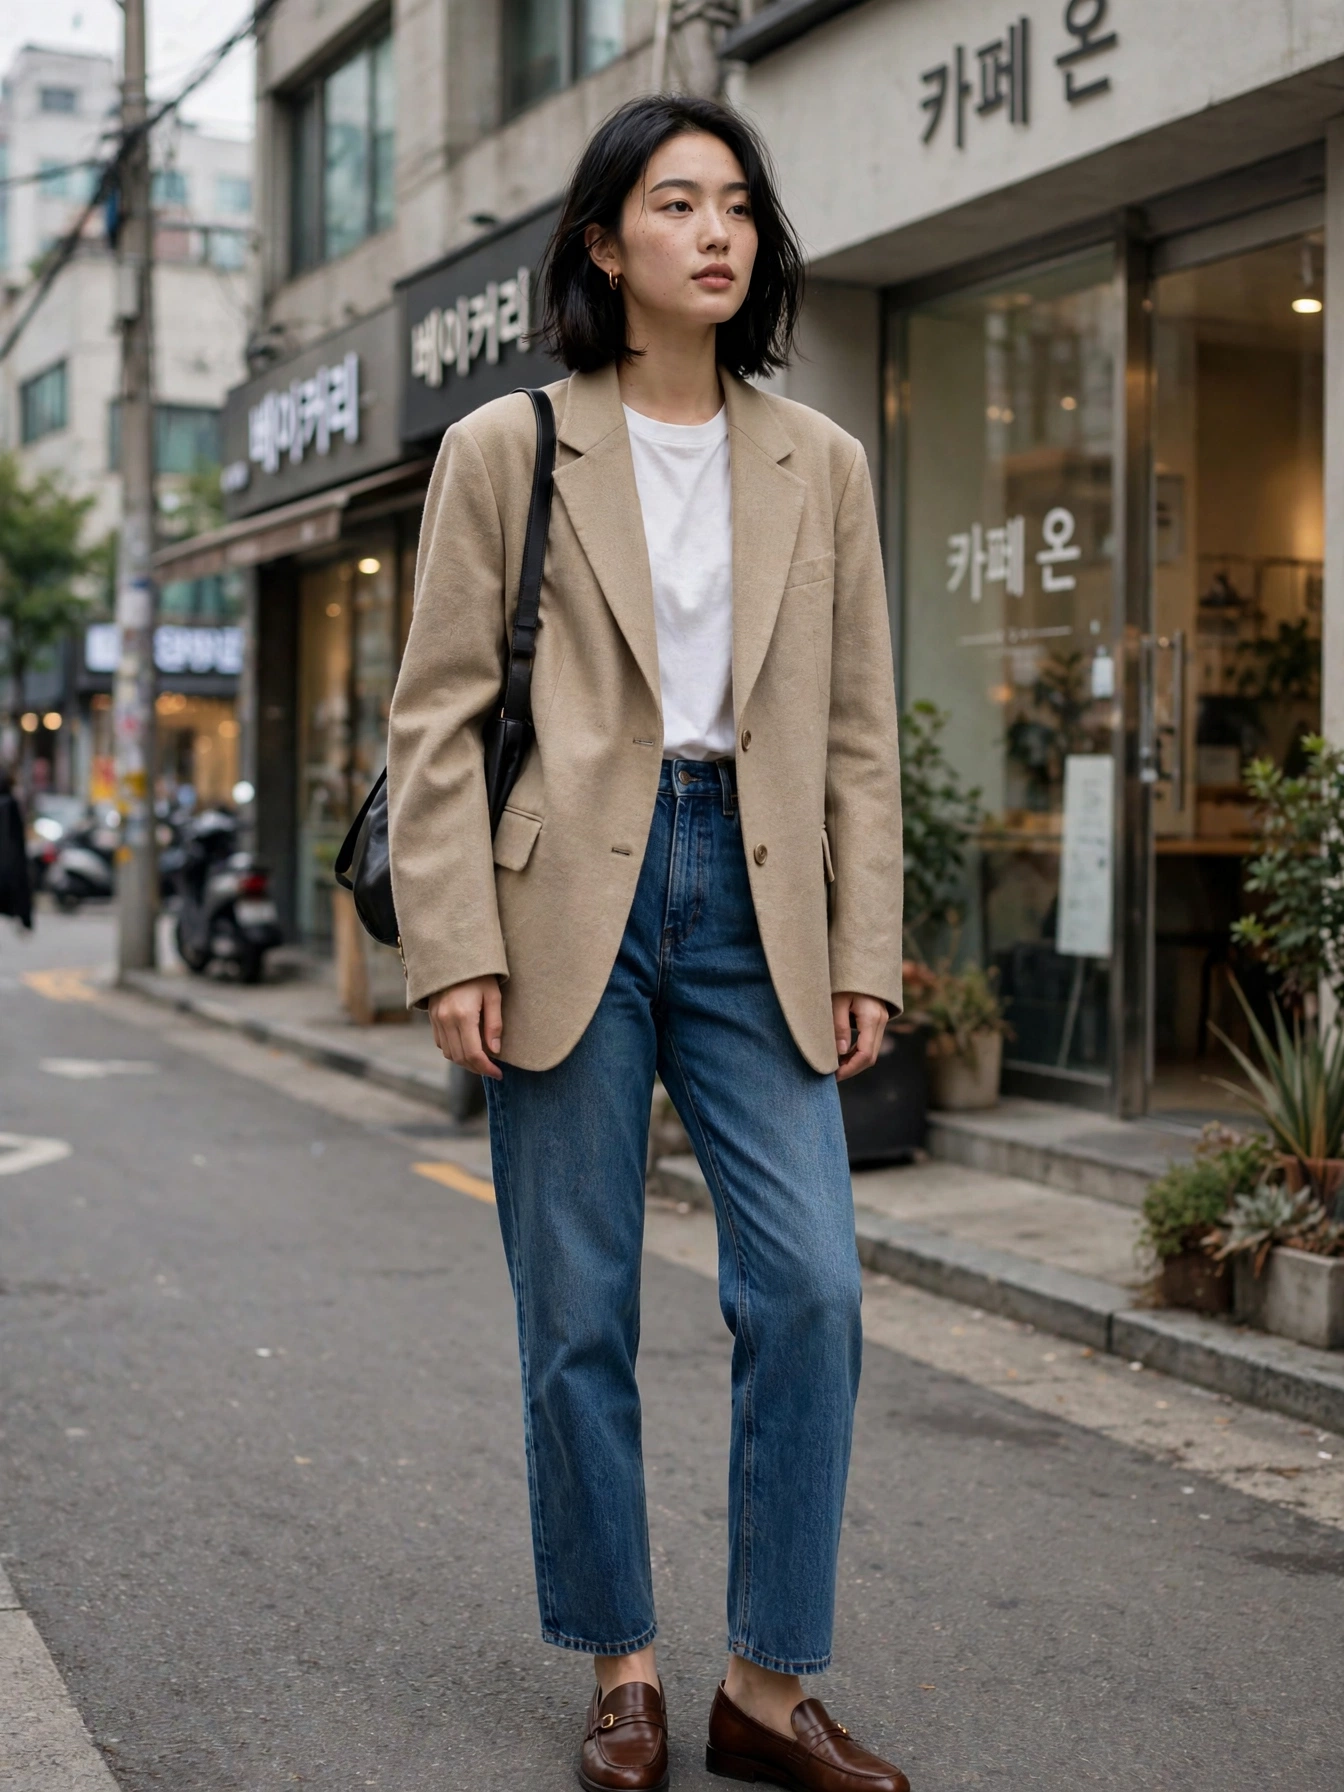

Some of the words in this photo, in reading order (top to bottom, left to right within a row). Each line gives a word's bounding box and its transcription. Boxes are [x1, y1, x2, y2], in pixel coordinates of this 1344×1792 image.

[920, 15, 1029, 149] 카페
[1055, 0, 1118, 104] 온
[411, 266, 530, 388] 베이커리
[947, 515, 1025, 603] 카페
[1036, 507, 1082, 591] 온
